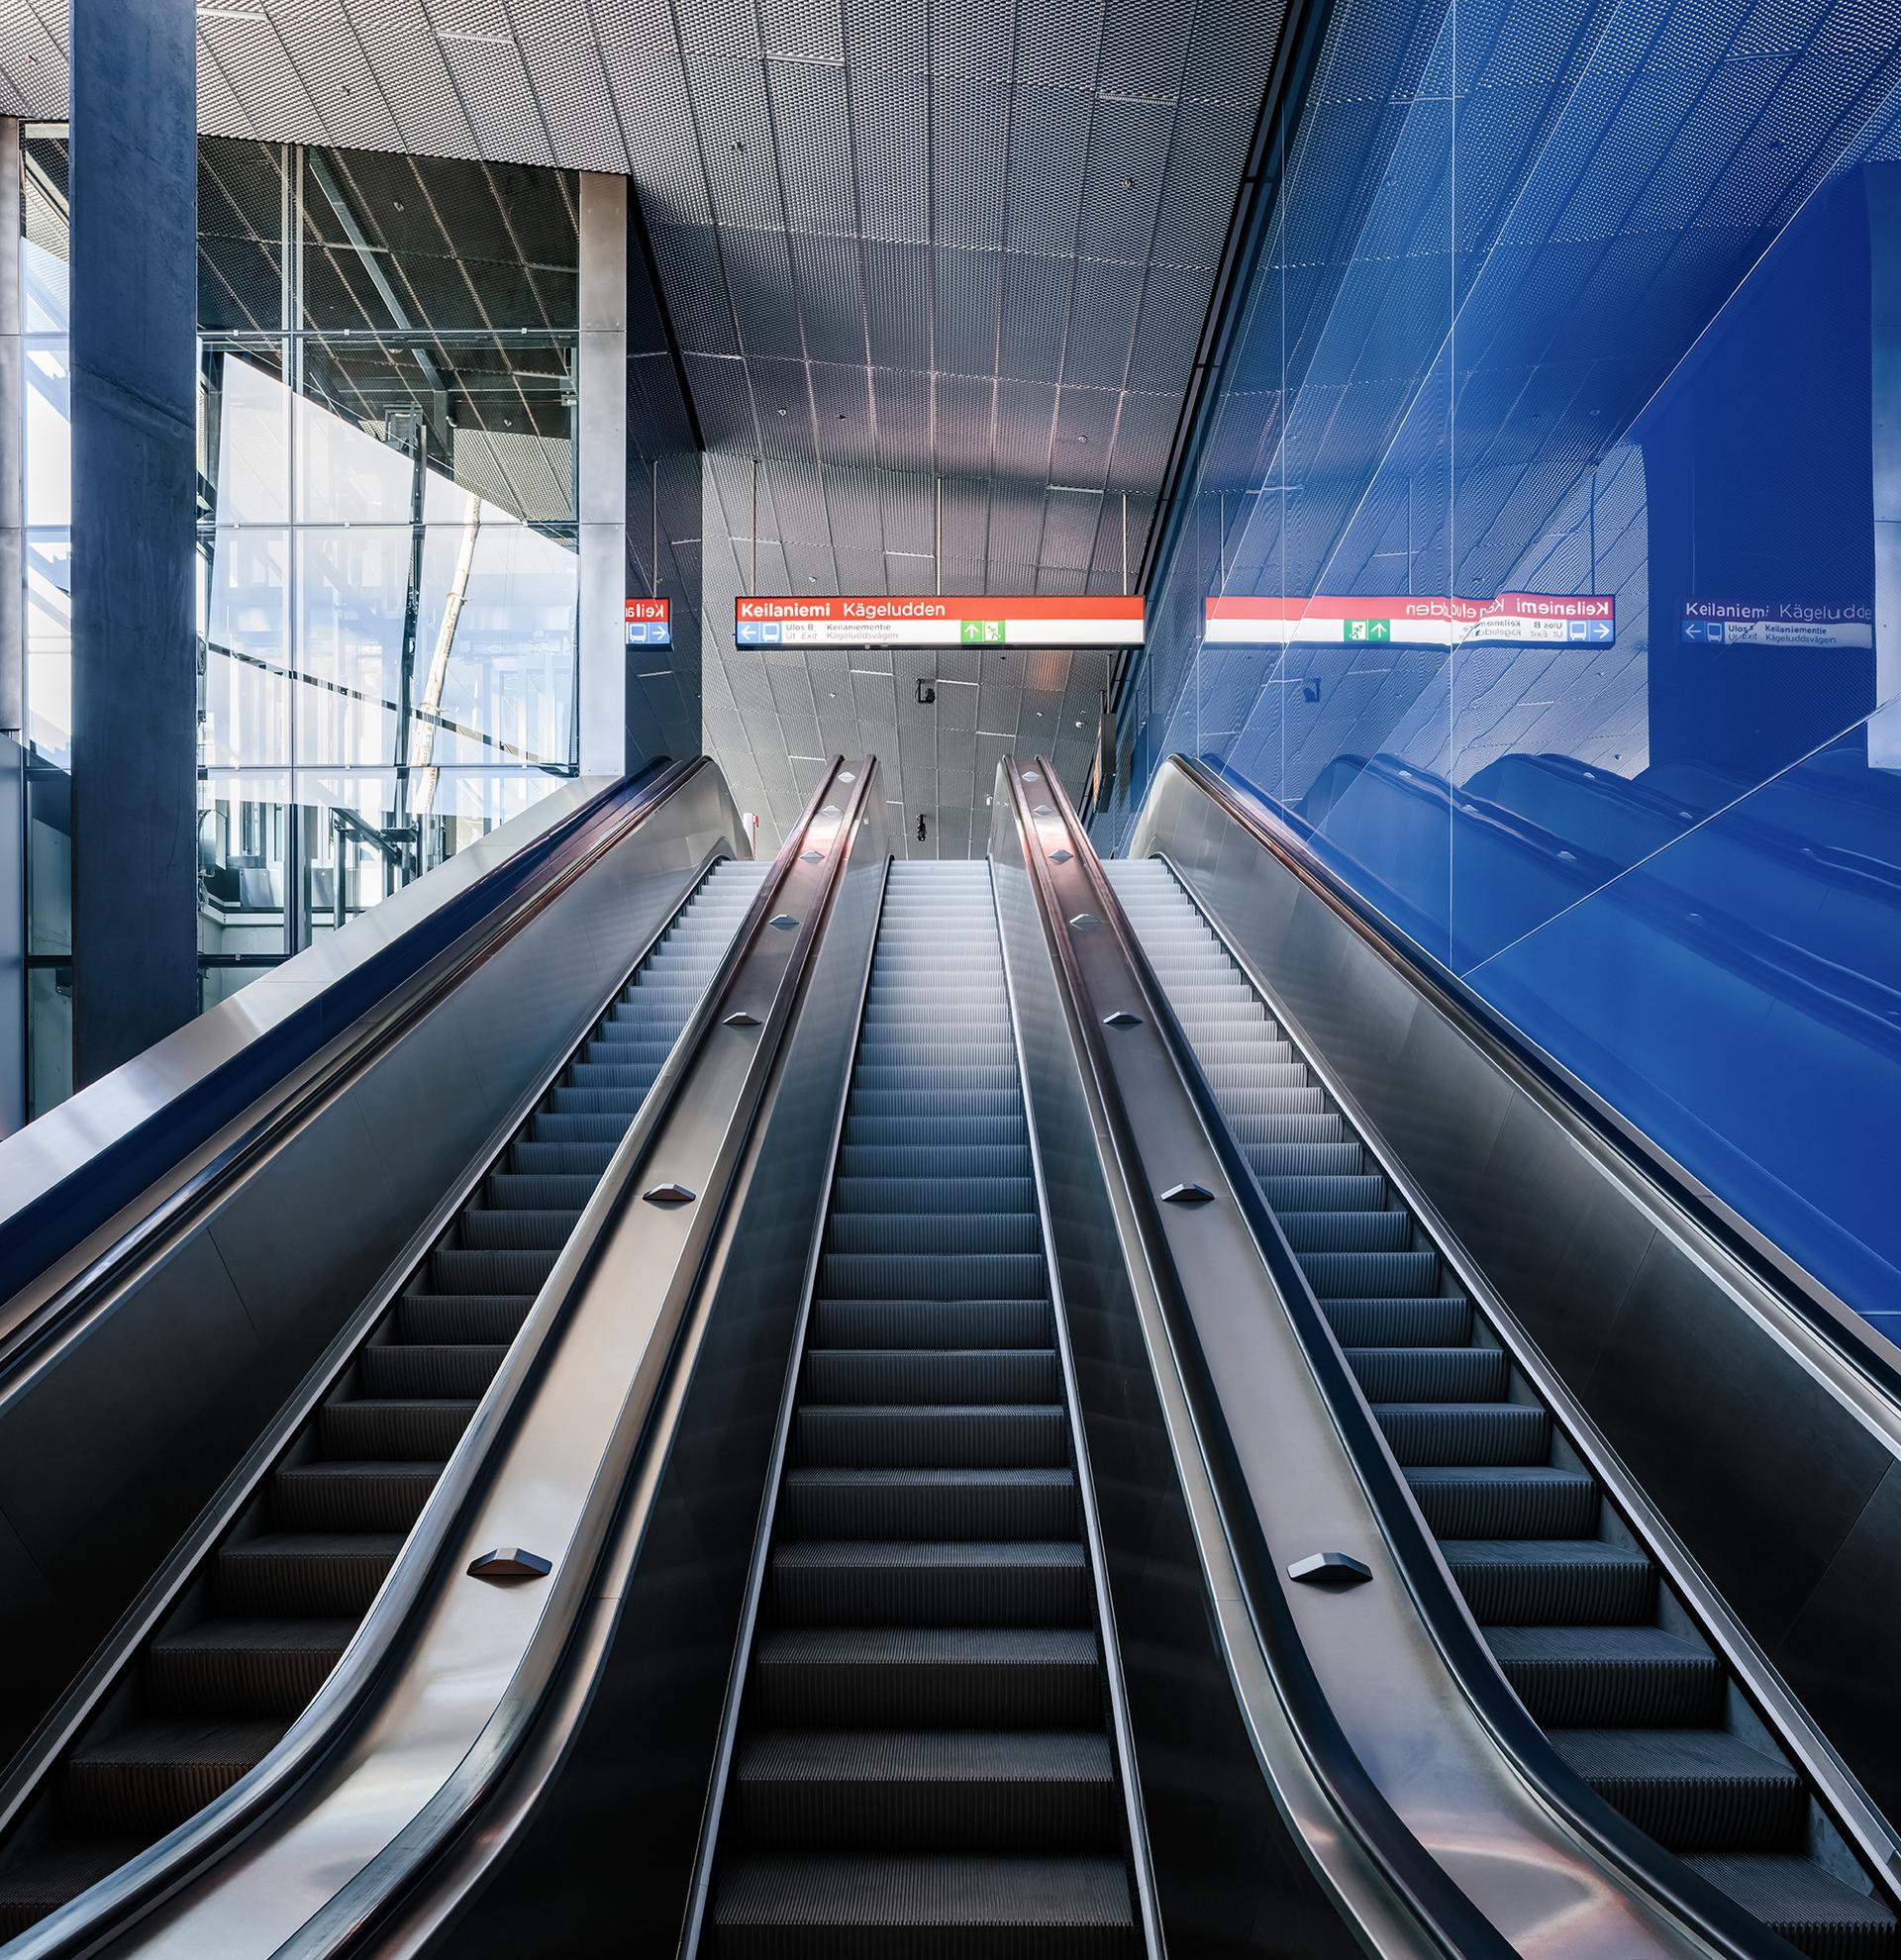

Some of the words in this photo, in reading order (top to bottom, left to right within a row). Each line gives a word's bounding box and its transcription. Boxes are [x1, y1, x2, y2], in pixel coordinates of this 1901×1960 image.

[742, 602, 831, 618] Keilaniemi
[843, 601, 946, 622] Kägeludden
[1685, 603, 1769, 619] Keilaniemi
